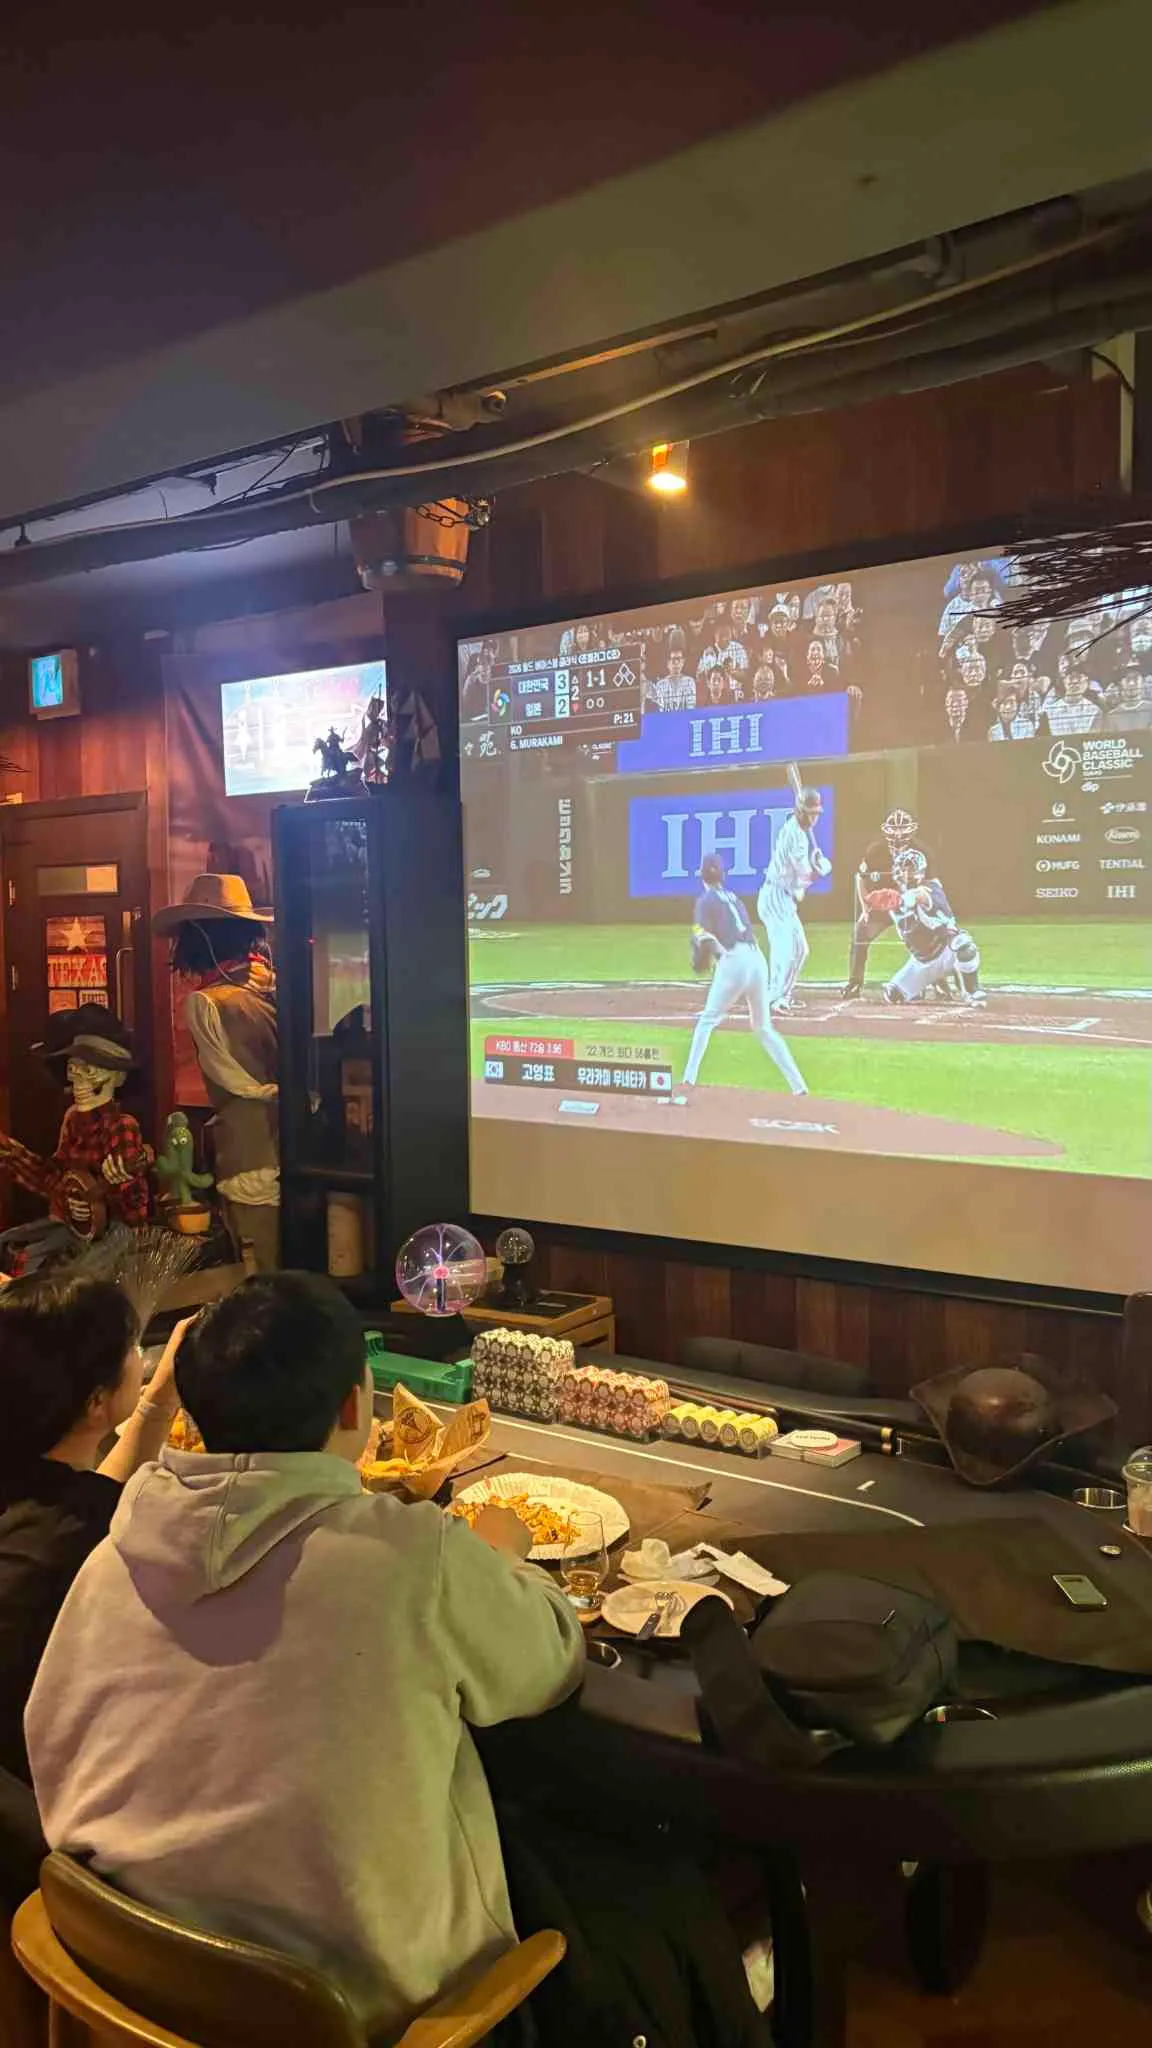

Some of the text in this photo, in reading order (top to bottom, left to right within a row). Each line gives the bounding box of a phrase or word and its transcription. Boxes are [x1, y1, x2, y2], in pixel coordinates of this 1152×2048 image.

[518, 673, 567, 694] 대한민국 3
[586, 668, 606, 688] 1-1
[571, 686, 580, 701] 2
[525, 699, 567, 718] 일본 2
[689, 713, 764, 757] IHI
[519, 736, 563, 749] MURAKAMI
[1083, 738, 1126, 751] WORLD
[1083, 748, 1144, 761] BASEBALL
[1082, 758, 1134, 771] CLASSIC
[1036, 833, 1081, 844] KONAMI
[1052, 860, 1080, 870] MUFG
[1100, 858, 1145, 869] TENTIAL
[1035, 887, 1079, 898] SEIKO
[1106, 884, 1137, 899] IHI
[522, 1063, 556, 1082] 고영표
